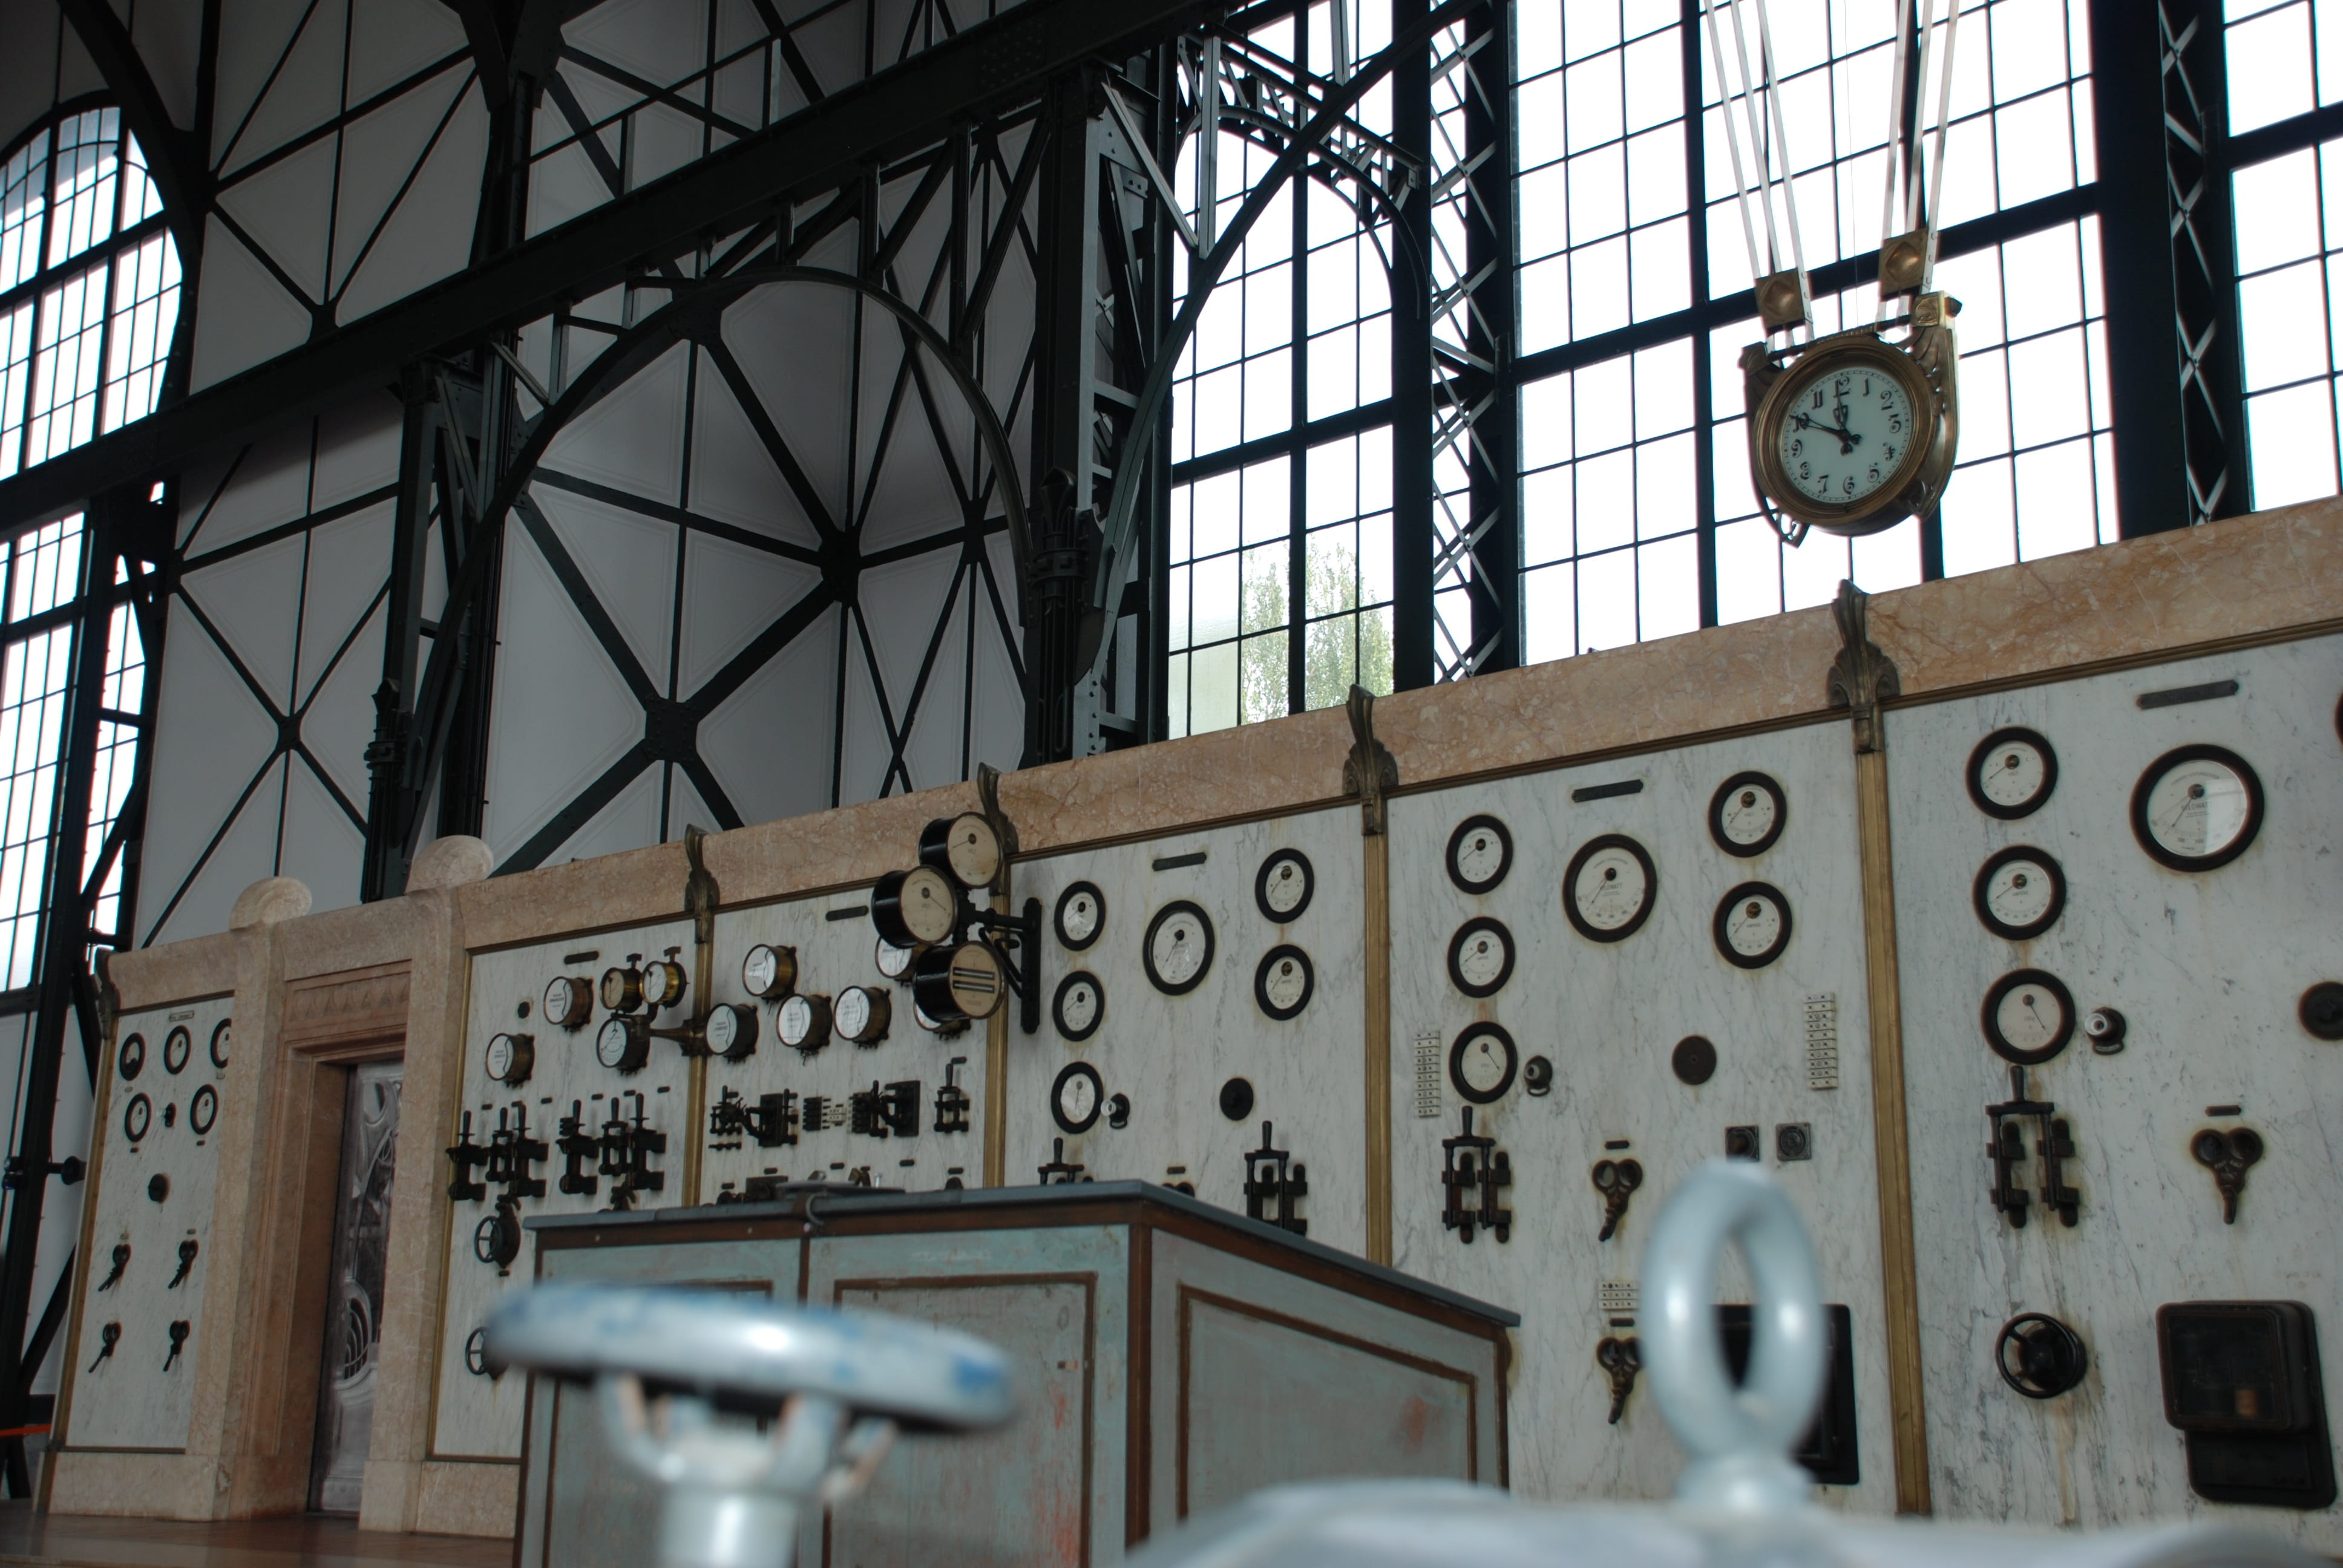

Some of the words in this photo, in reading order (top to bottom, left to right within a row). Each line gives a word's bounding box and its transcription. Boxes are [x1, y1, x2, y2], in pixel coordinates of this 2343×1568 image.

[1833, 376, 1851, 398] 12
[1863, 377, 1870, 397] 1
[1811, 389, 1824, 410] 11
[1880, 390, 1894, 411] 2
[1888, 413, 1901, 434] 3
[1791, 439, 1803, 459] 9
[1883, 442, 1896, 462] 4
[1800, 462, 1811, 480] 8
[1867, 462, 1879, 483] 5
[1817, 474, 1829, 495] 7
[1843, 475, 1855, 495] 6
